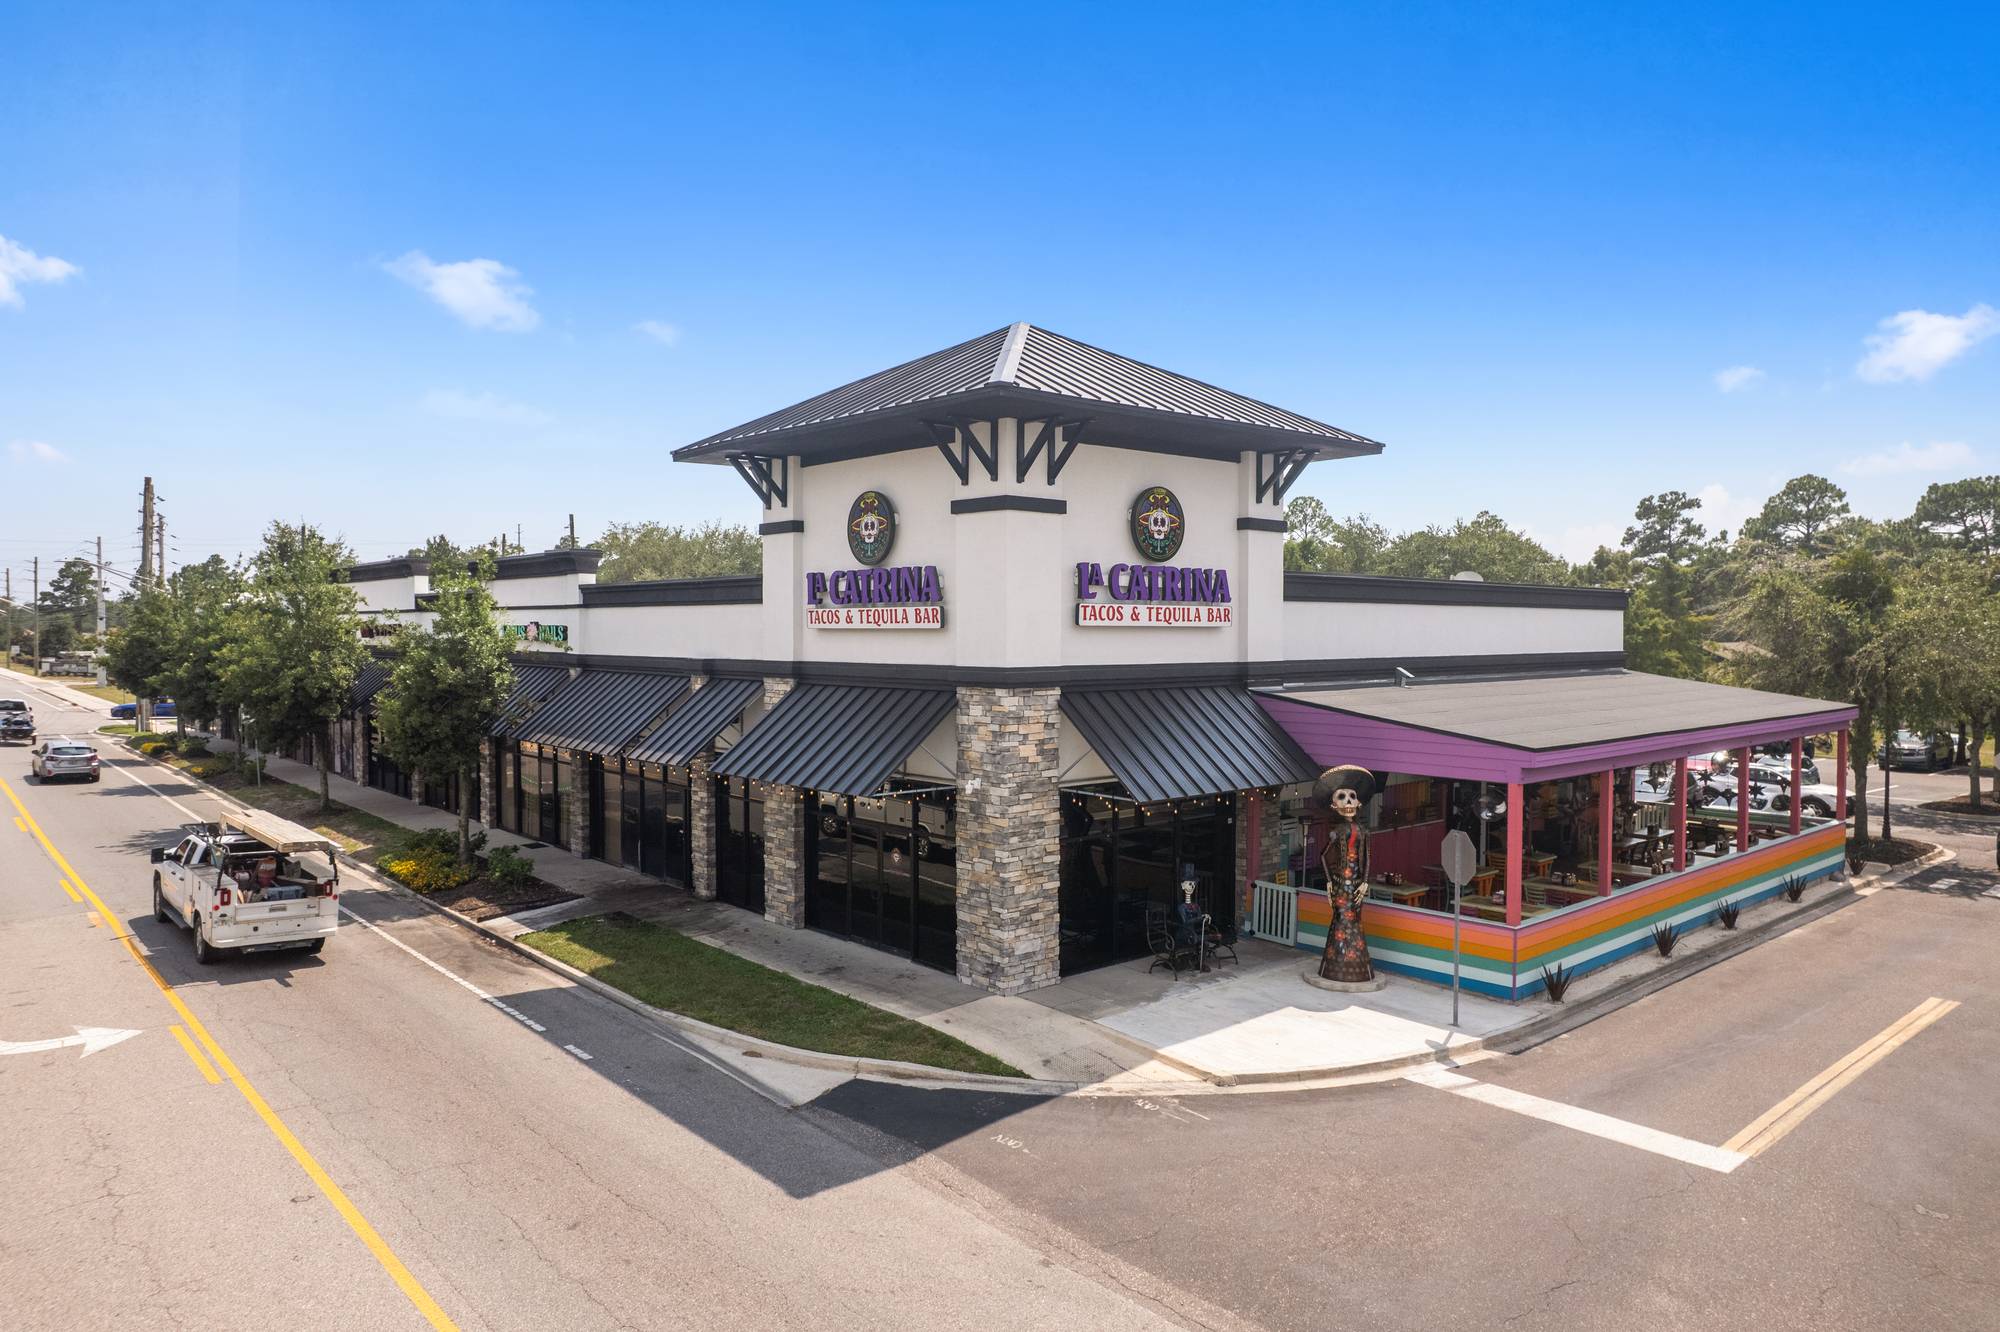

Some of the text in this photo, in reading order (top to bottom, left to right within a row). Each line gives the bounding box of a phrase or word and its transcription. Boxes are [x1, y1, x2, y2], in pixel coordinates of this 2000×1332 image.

[829, 566, 943, 605] CATRINA
[1108, 563, 1232, 603] CATRINA
[808, 607, 940, 626] TACOS & TEQUILA BAR
[1081, 605, 1231, 624] TACOS & TEQUILA BAR
